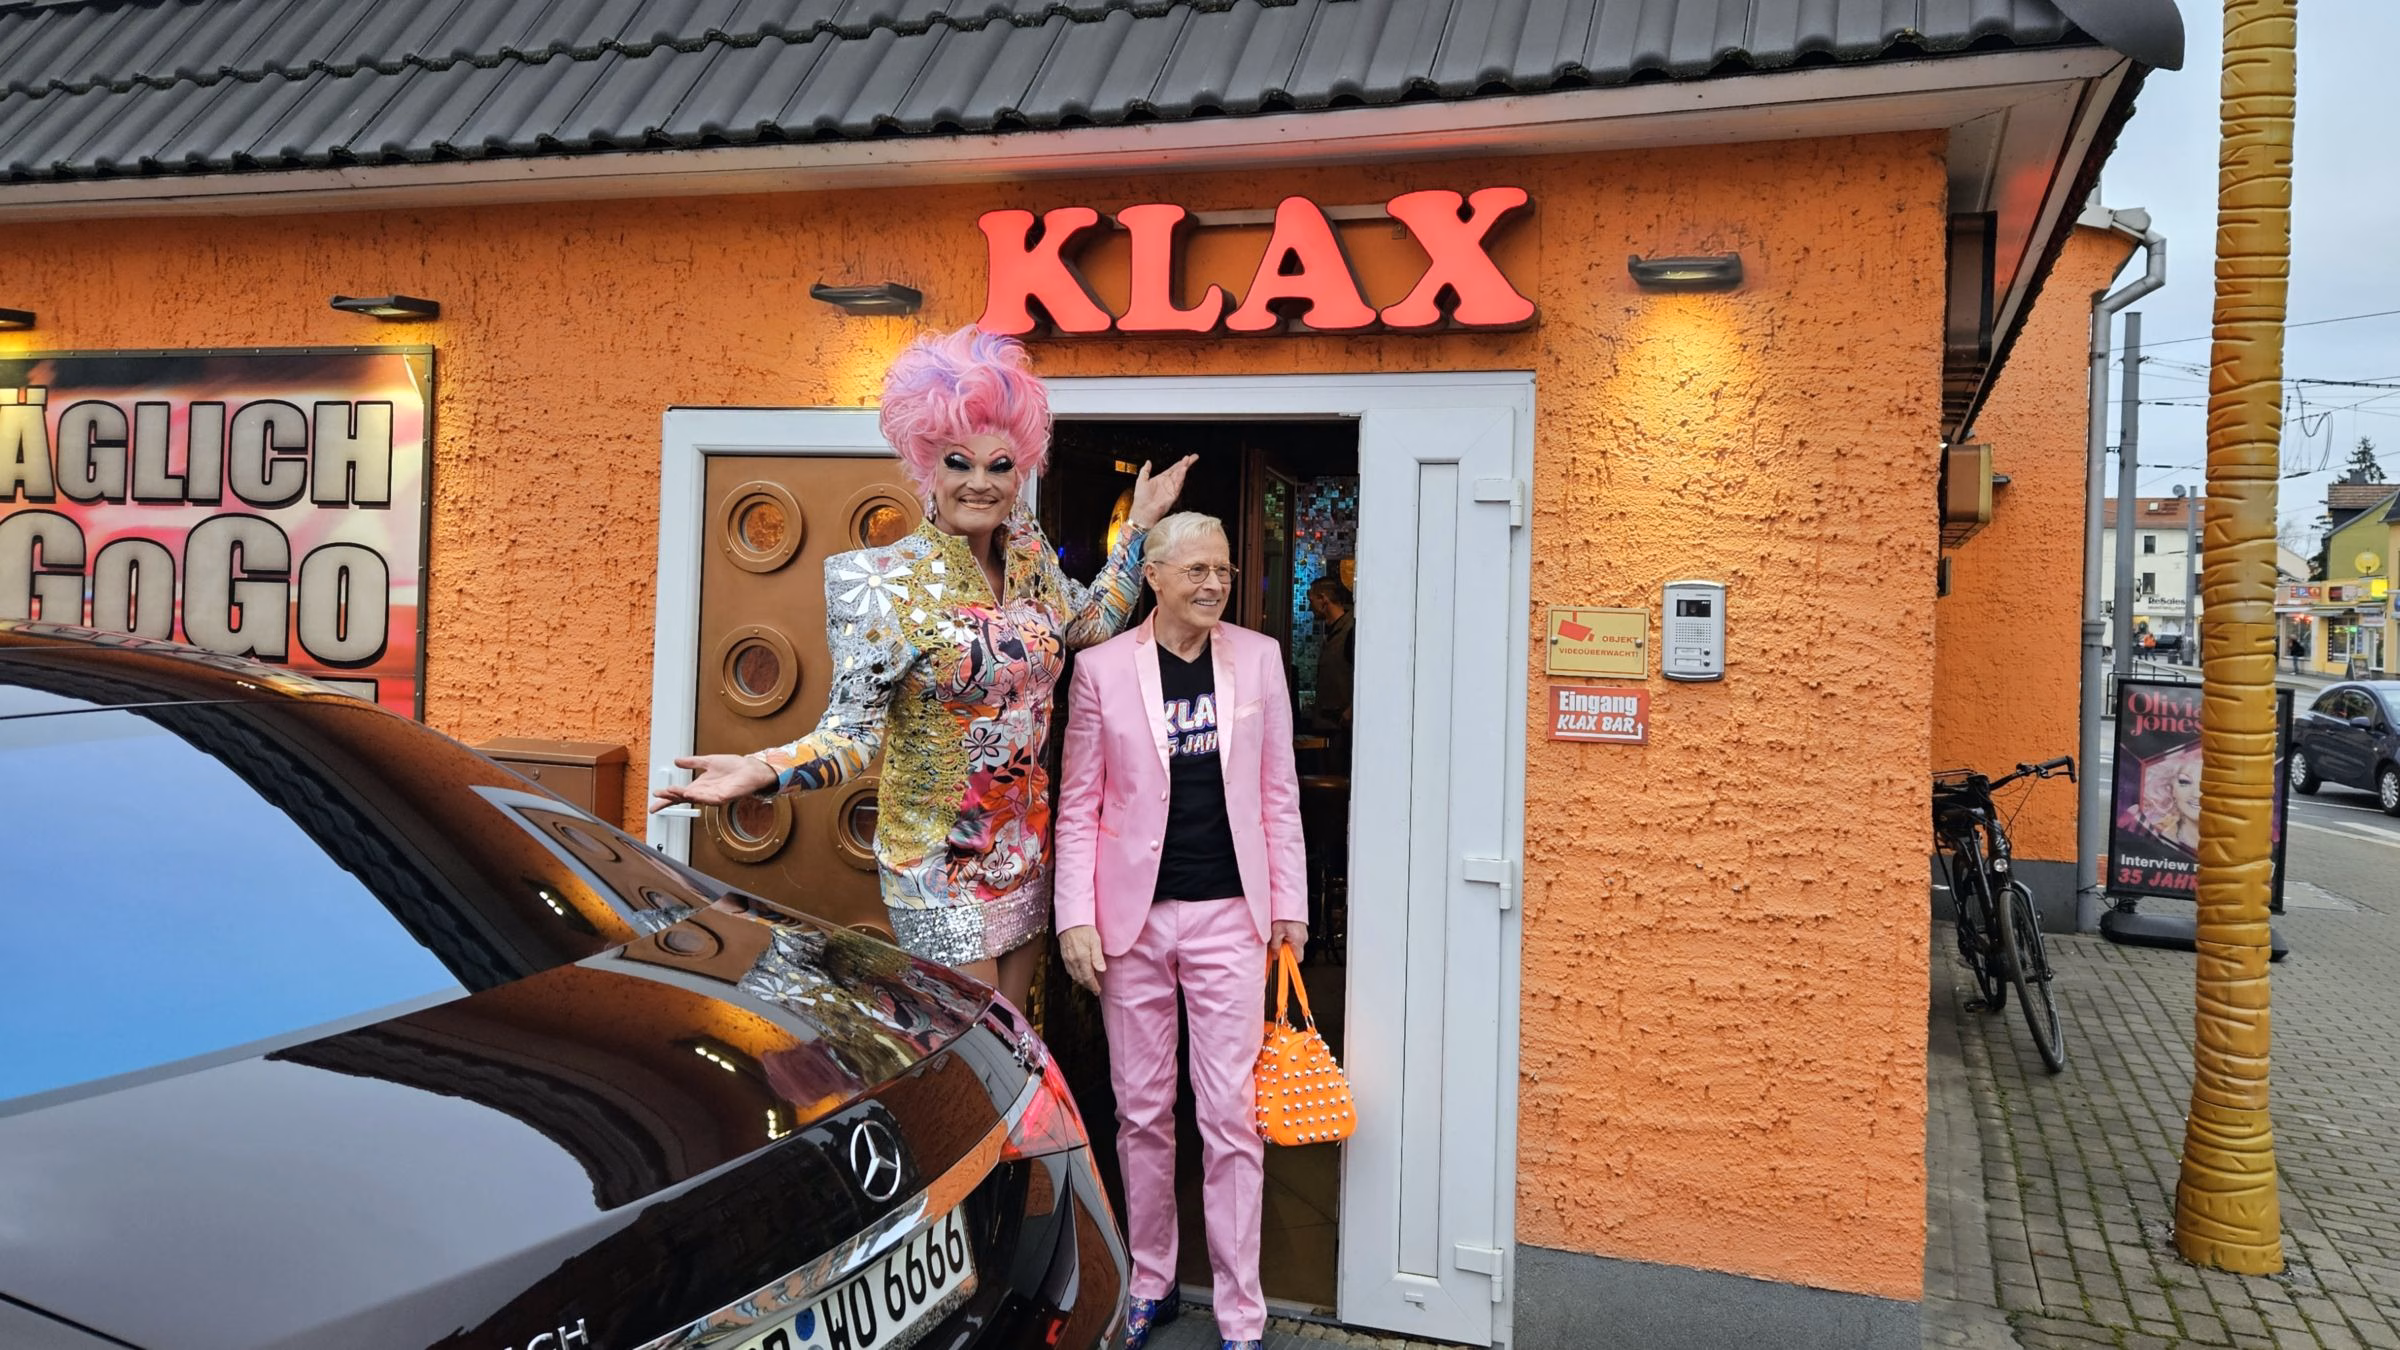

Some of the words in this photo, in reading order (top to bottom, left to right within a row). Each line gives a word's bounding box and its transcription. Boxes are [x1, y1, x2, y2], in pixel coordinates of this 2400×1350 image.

[977, 186, 1537, 335] KLAX
[1602, 635, 1640, 644] OBJEKT
[1164, 693, 1216, 736] KLA
[1559, 691, 1638, 716] Eingang
[1557, 715, 1598, 731] KLAX
[1602, 717, 1634, 733] BAR
[1168, 738, 1178, 755] 5
[1181, 731, 1219, 754] JAH
[2121, 854, 2189, 871] Interview
[2118, 868, 2142, 885] 35
[885, 1210, 964, 1322] 6666
